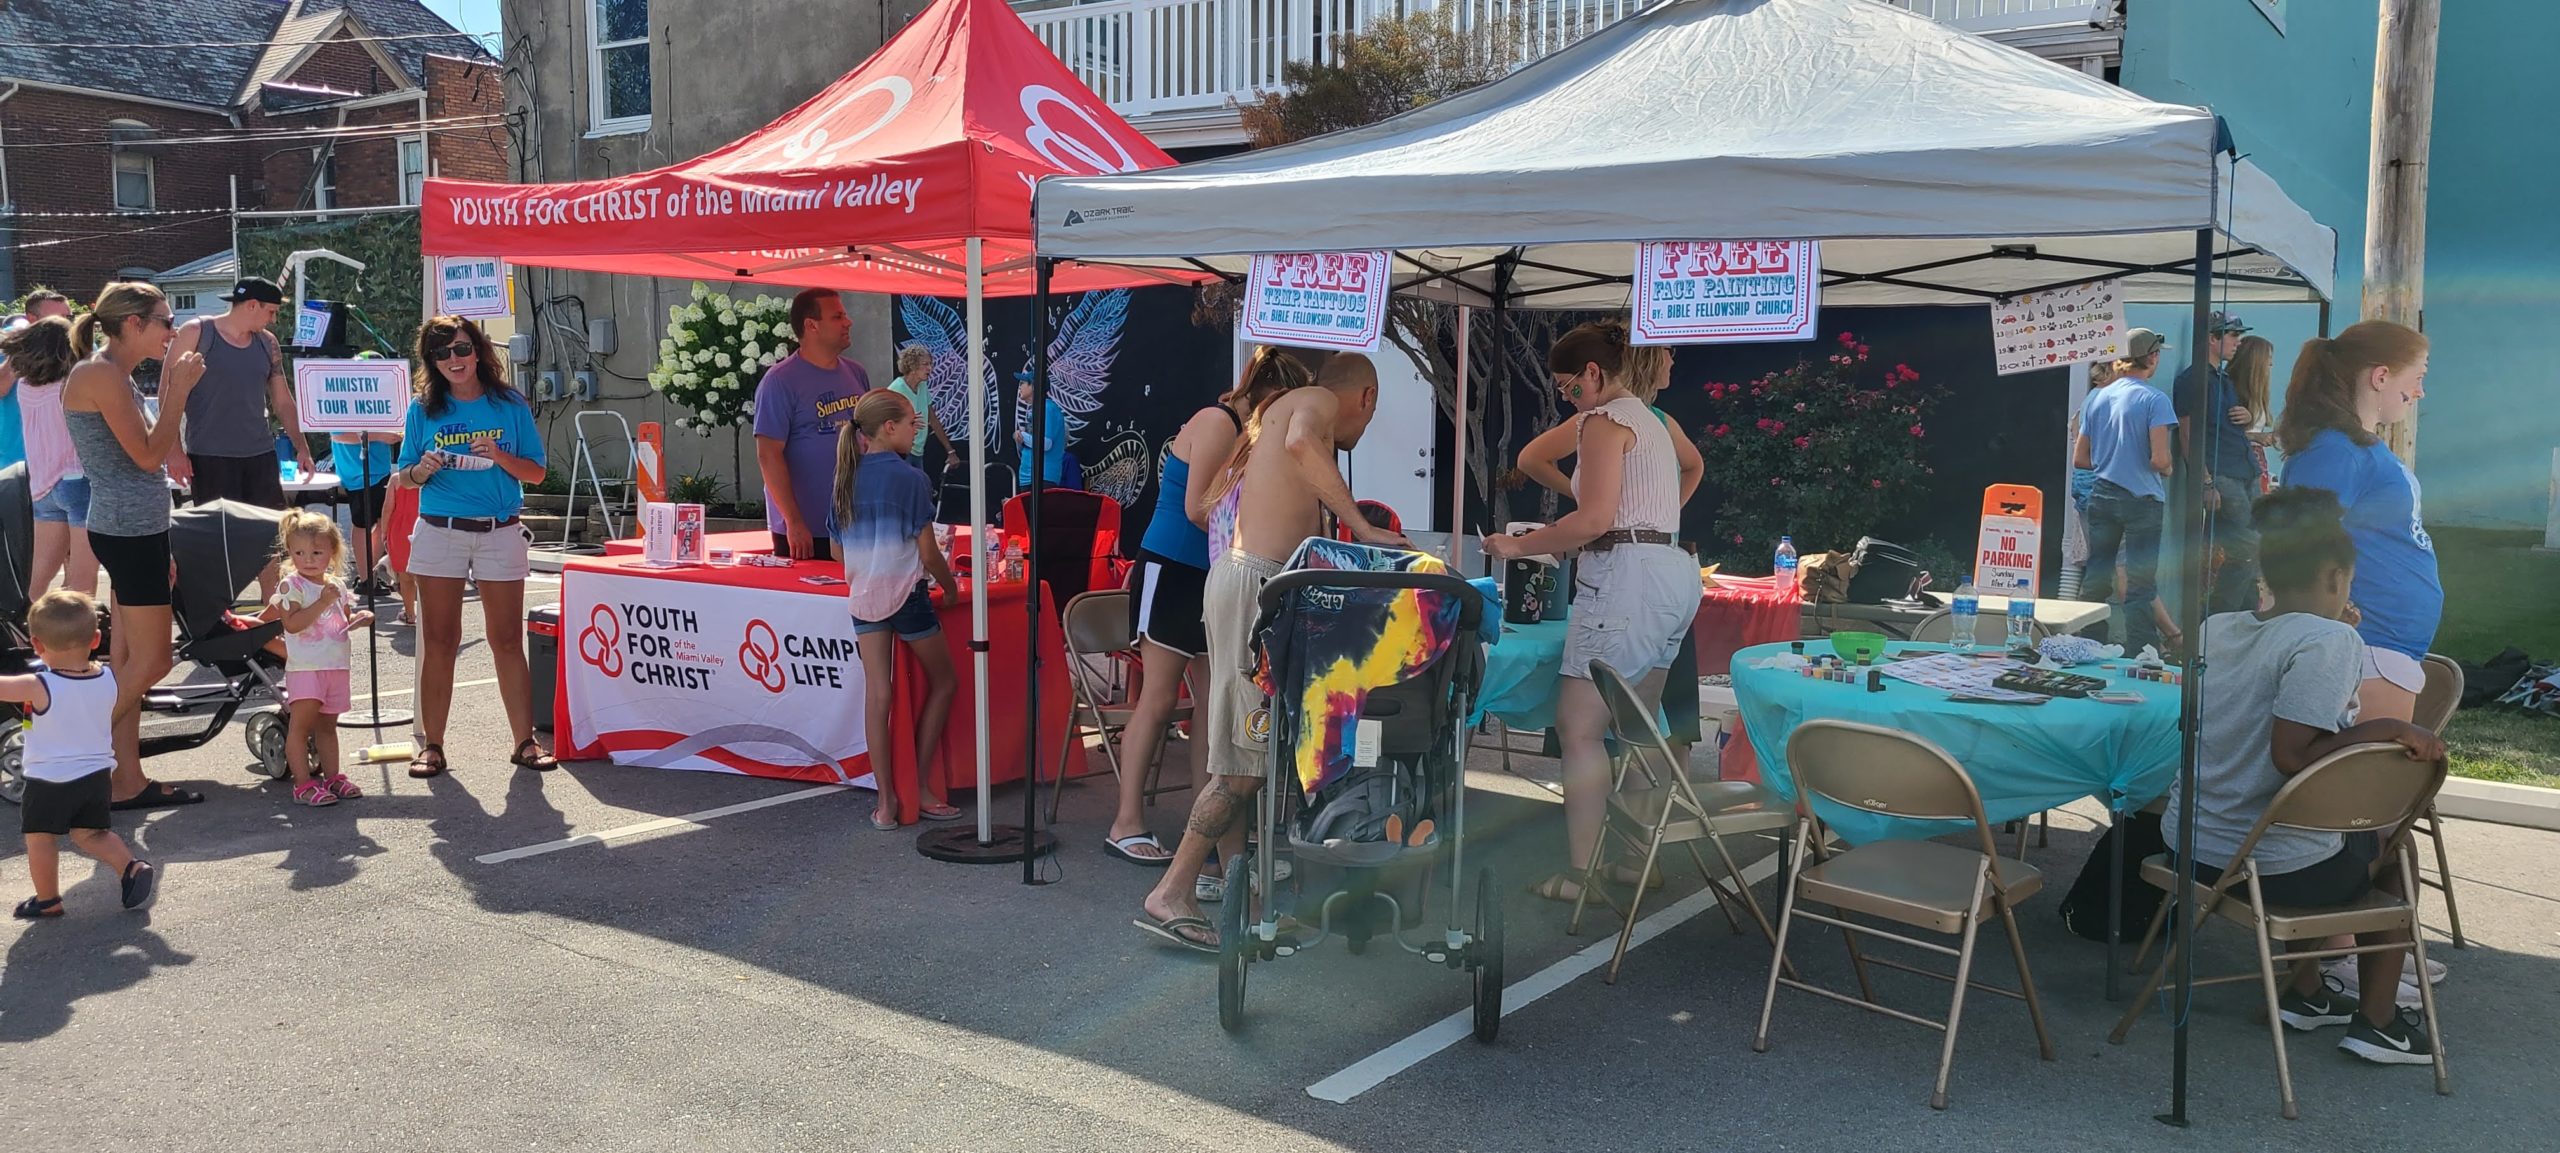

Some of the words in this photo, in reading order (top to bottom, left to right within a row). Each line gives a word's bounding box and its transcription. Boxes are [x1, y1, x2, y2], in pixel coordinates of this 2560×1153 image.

[449, 197, 519, 225] YOUTH
[524, 198, 569, 225] FOR
[573, 188, 661, 223] CHRIST
[666, 184, 690, 217] of
[695, 183, 733, 216] the
[741, 181, 830, 214] Miami
[833, 173, 924, 214] Valley
[1658, 241, 1791, 279] FREE
[445, 265, 474, 281] MINISTRY
[476, 263, 495, 278] TOUR
[1267, 252, 1369, 293] FREE
[446, 287, 464, 301] SIGNUP
[466, 287, 472, 299] &
[474, 284, 498, 299] TICKETS
[1652, 278, 1696, 301] FACE
[1703, 275, 1795, 299] PAINTING
[1304, 290, 1367, 313] TATTOOS
[1652, 309, 1663, 320] BY:
[1667, 303, 1690, 319] BIBLE
[1695, 301, 1750, 317] FELLOWSHIP
[1755, 300, 1793, 315] CHURCH
[1271, 309, 1289, 323] BIBLE
[1292, 311, 1333, 327] FELLOWSHIP
[1336, 315, 1366, 330] CHURCH
[325, 376, 380, 393] MINISTRY
[317, 399, 348, 415] TOUR
[355, 399, 392, 415] INSIDE
[2000, 536, 2017, 551] NO
[1982, 550, 2033, 569] PARKING
[1991, 568, 2015, 580] Sunday
[621, 603, 699, 634] YOUTH
[627, 632, 673, 659] FOR
[674, 639, 682, 648] of
[683, 640, 696, 650] the
[676, 652, 700, 663] Miami
[701, 653, 724, 667] Valley
[630, 660, 711, 691] CHRIST
[791, 662, 843, 689] LIFE
